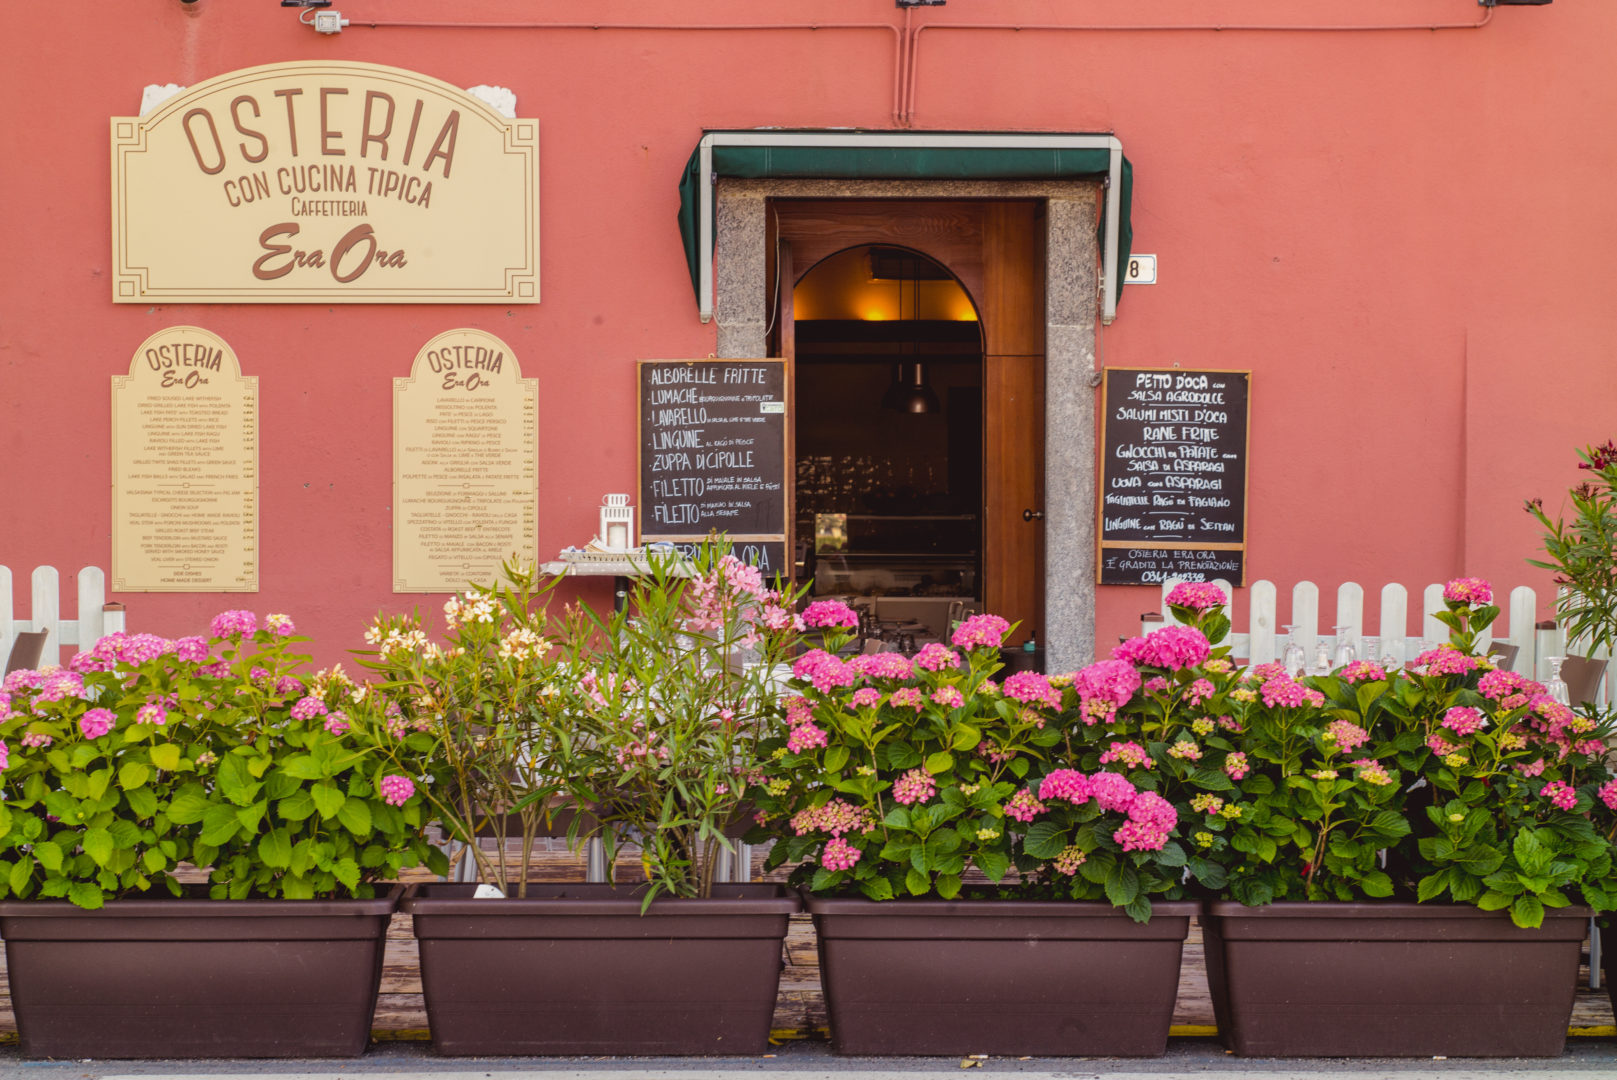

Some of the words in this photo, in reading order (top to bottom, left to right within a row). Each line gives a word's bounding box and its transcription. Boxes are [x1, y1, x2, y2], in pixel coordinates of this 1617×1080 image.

[183, 87, 460, 178] OSTERIA
[224, 171, 271, 208] CON
[277, 164, 357, 195] CUCINA
[368, 167, 432, 209] TIPICA
[253, 222, 326, 281] Era
[330, 223, 408, 283] Ora
[146, 344, 223, 372] OSTERIA
[427, 346, 503, 374] OSTERIA
[161, 370, 183, 388] Era
[185, 370, 208, 388] Ora
[442, 372, 465, 390] Era
[466, 373, 490, 391] Ora
[652, 367, 716, 385] ALBORELLE
[724, 365, 767, 384] FRITTE
[1136, 374, 1172, 389] PETTO
[1176, 372, 1208, 389] D'OCA
[652, 388, 698, 405] LUMACHE
[1128, 391, 1162, 401] SALSA
[1166, 392, 1225, 404] AGRODOLCE
[652, 408, 706, 426] LAVARELLO
[1116, 407, 1156, 420] SALUMI
[1160, 409, 1188, 421] MISTI
[1195, 409, 1227, 423] D'OCA
[653, 427, 704, 450] LINGUINE
[1144, 426, 1177, 440] RANE
[1182, 427, 1219, 442] FRITTE
[652, 453, 691, 471] ZUPPA
[696, 451, 704, 471] DI
[706, 450, 754, 469] CIPOLLE
[1116, 444, 1166, 459] GNOCCHI
[1127, 460, 1158, 471] SALSA
[1174, 459, 1224, 472] ASPARAGI
[653, 476, 704, 497] FILETTO
[1112, 476, 1141, 488] UOVA
[1165, 476, 1222, 490] ASPARAGI
[1188, 495, 1230, 508] FAGIANO
[655, 502, 699, 523] FILETTO
[1105, 517, 1141, 531] LINGUINE
[1128, 550, 1168, 559] OSTERIA
[1196, 551, 1216, 560] ORA
[1119, 560, 1156, 572] GRADITA
[1177, 560, 1239, 570] PRENOTAZIONE
